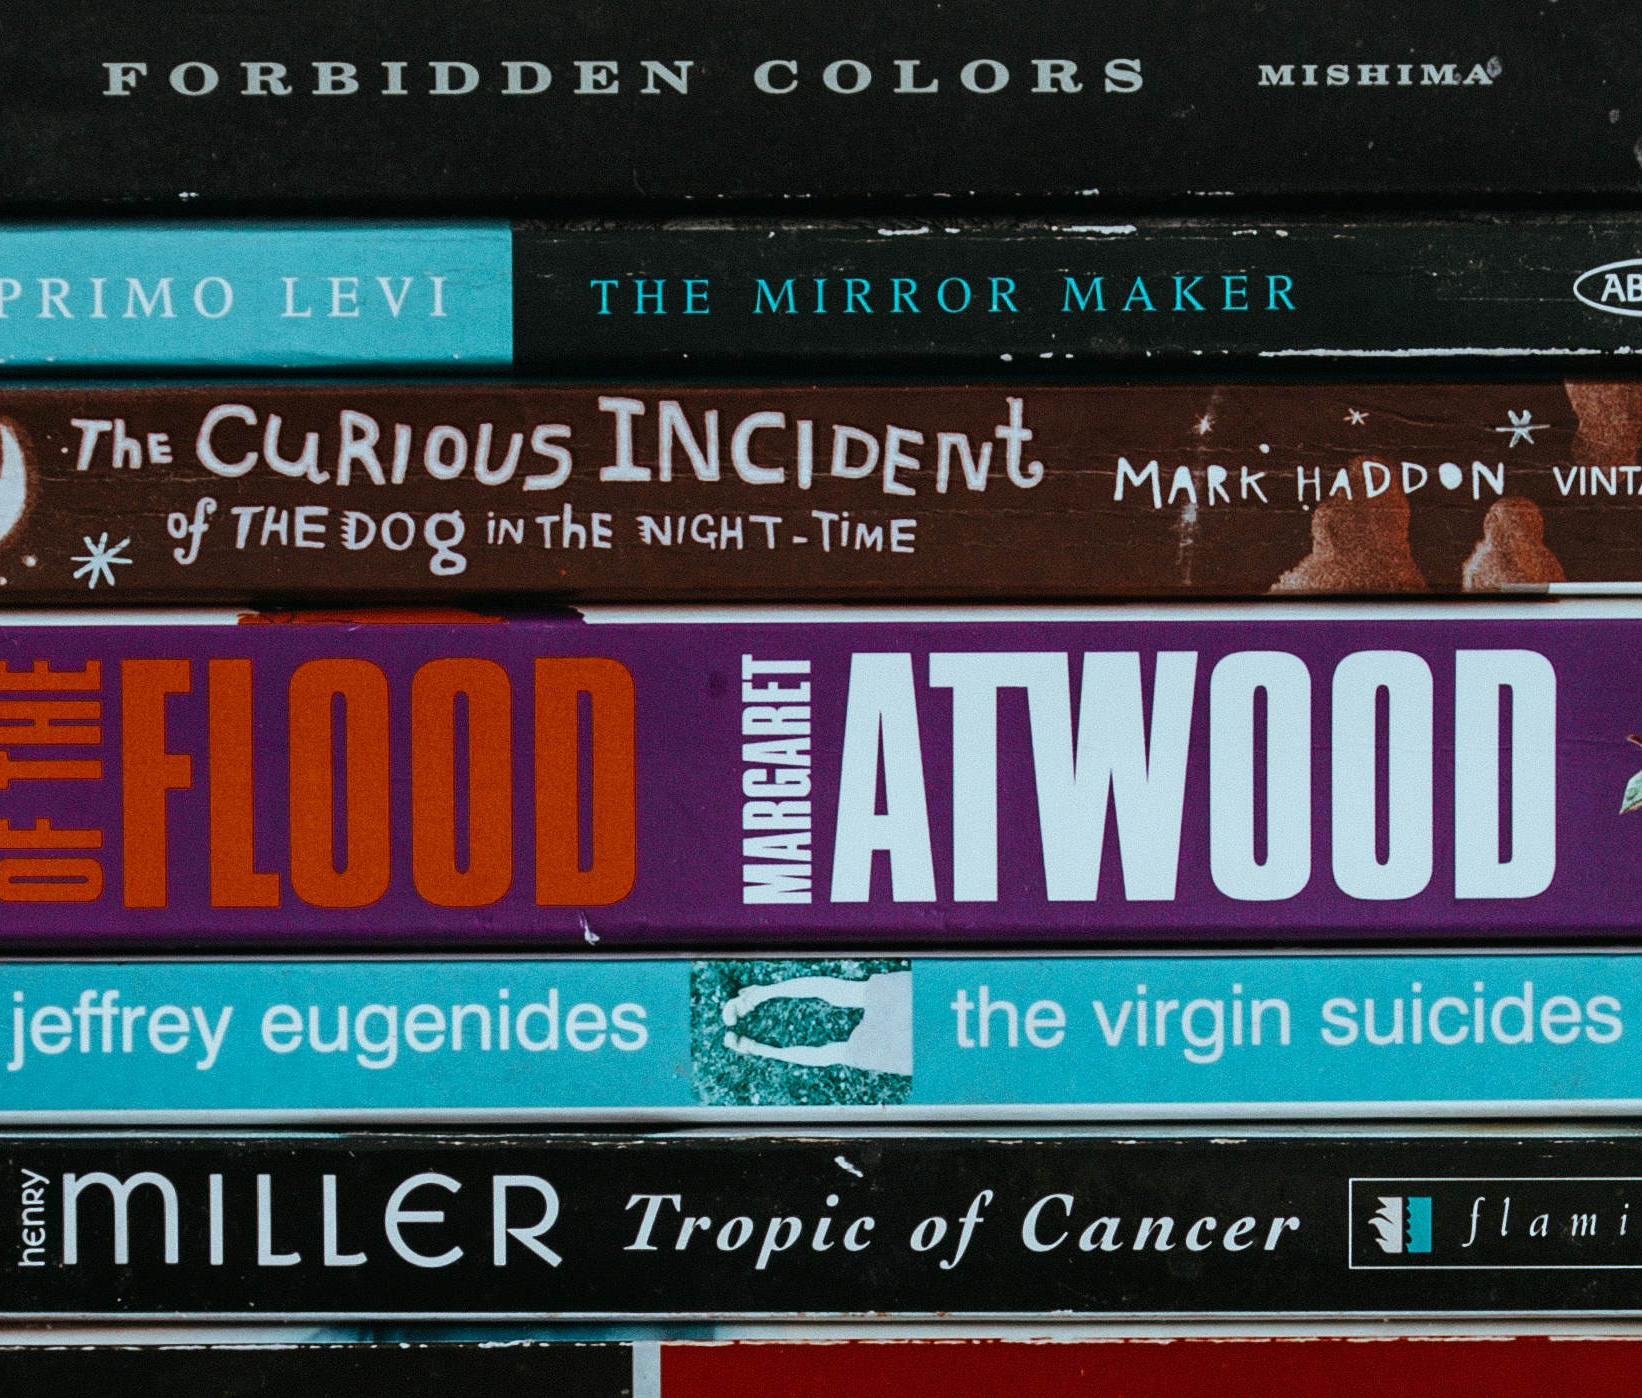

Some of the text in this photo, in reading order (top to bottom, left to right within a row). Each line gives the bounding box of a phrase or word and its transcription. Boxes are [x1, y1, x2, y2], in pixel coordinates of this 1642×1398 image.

[102, 58, 1492, 96] FORBIDDEN COLORS MISHIMA
[281, 276, 446, 318] LEVI
[590, 274, 1295, 315] THE MIRROR MAKER
[1114, 457, 1505, 507] MARK HADDON
[121, 656, 636, 908] FLOOD
[742, 654, 812, 904] MARGARET
[830, 649, 1556, 902] ATWOOD
[7, 988, 649, 1072] jeffrey eugenides
[950, 980, 1623, 1064] the virgin suicides
[623, 1190, 1300, 1270] Tropic of Cancer
